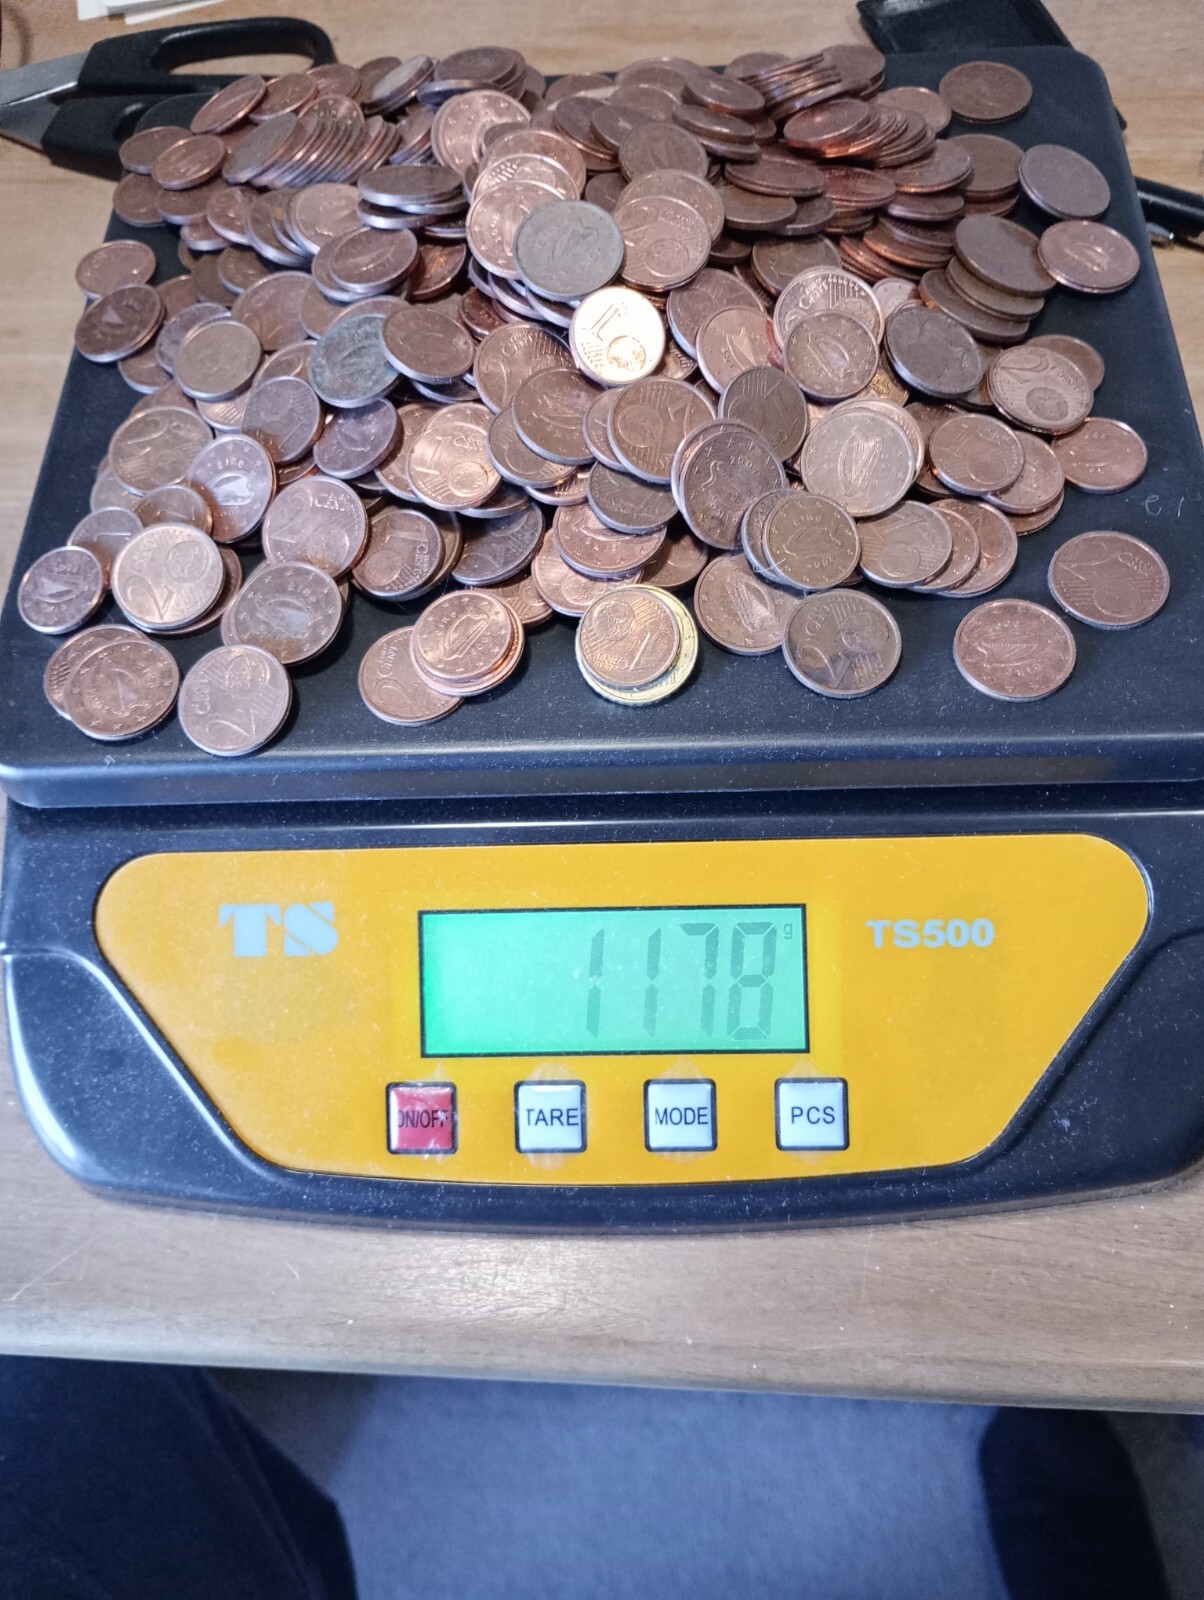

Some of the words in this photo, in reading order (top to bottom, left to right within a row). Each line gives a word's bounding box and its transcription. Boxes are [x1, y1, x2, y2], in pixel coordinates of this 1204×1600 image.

[219, 901, 339, 957] TS
[864, 917, 995, 949] TS500
[586, 921, 778, 1041] 1178
[783, 922, 793, 940] g
[397, 1109, 449, 1129] ON/OFF
[525, 1107, 580, 1127] TARE
[654, 1106, 709, 1126] MODE
[791, 1105, 836, 1125] PCS
